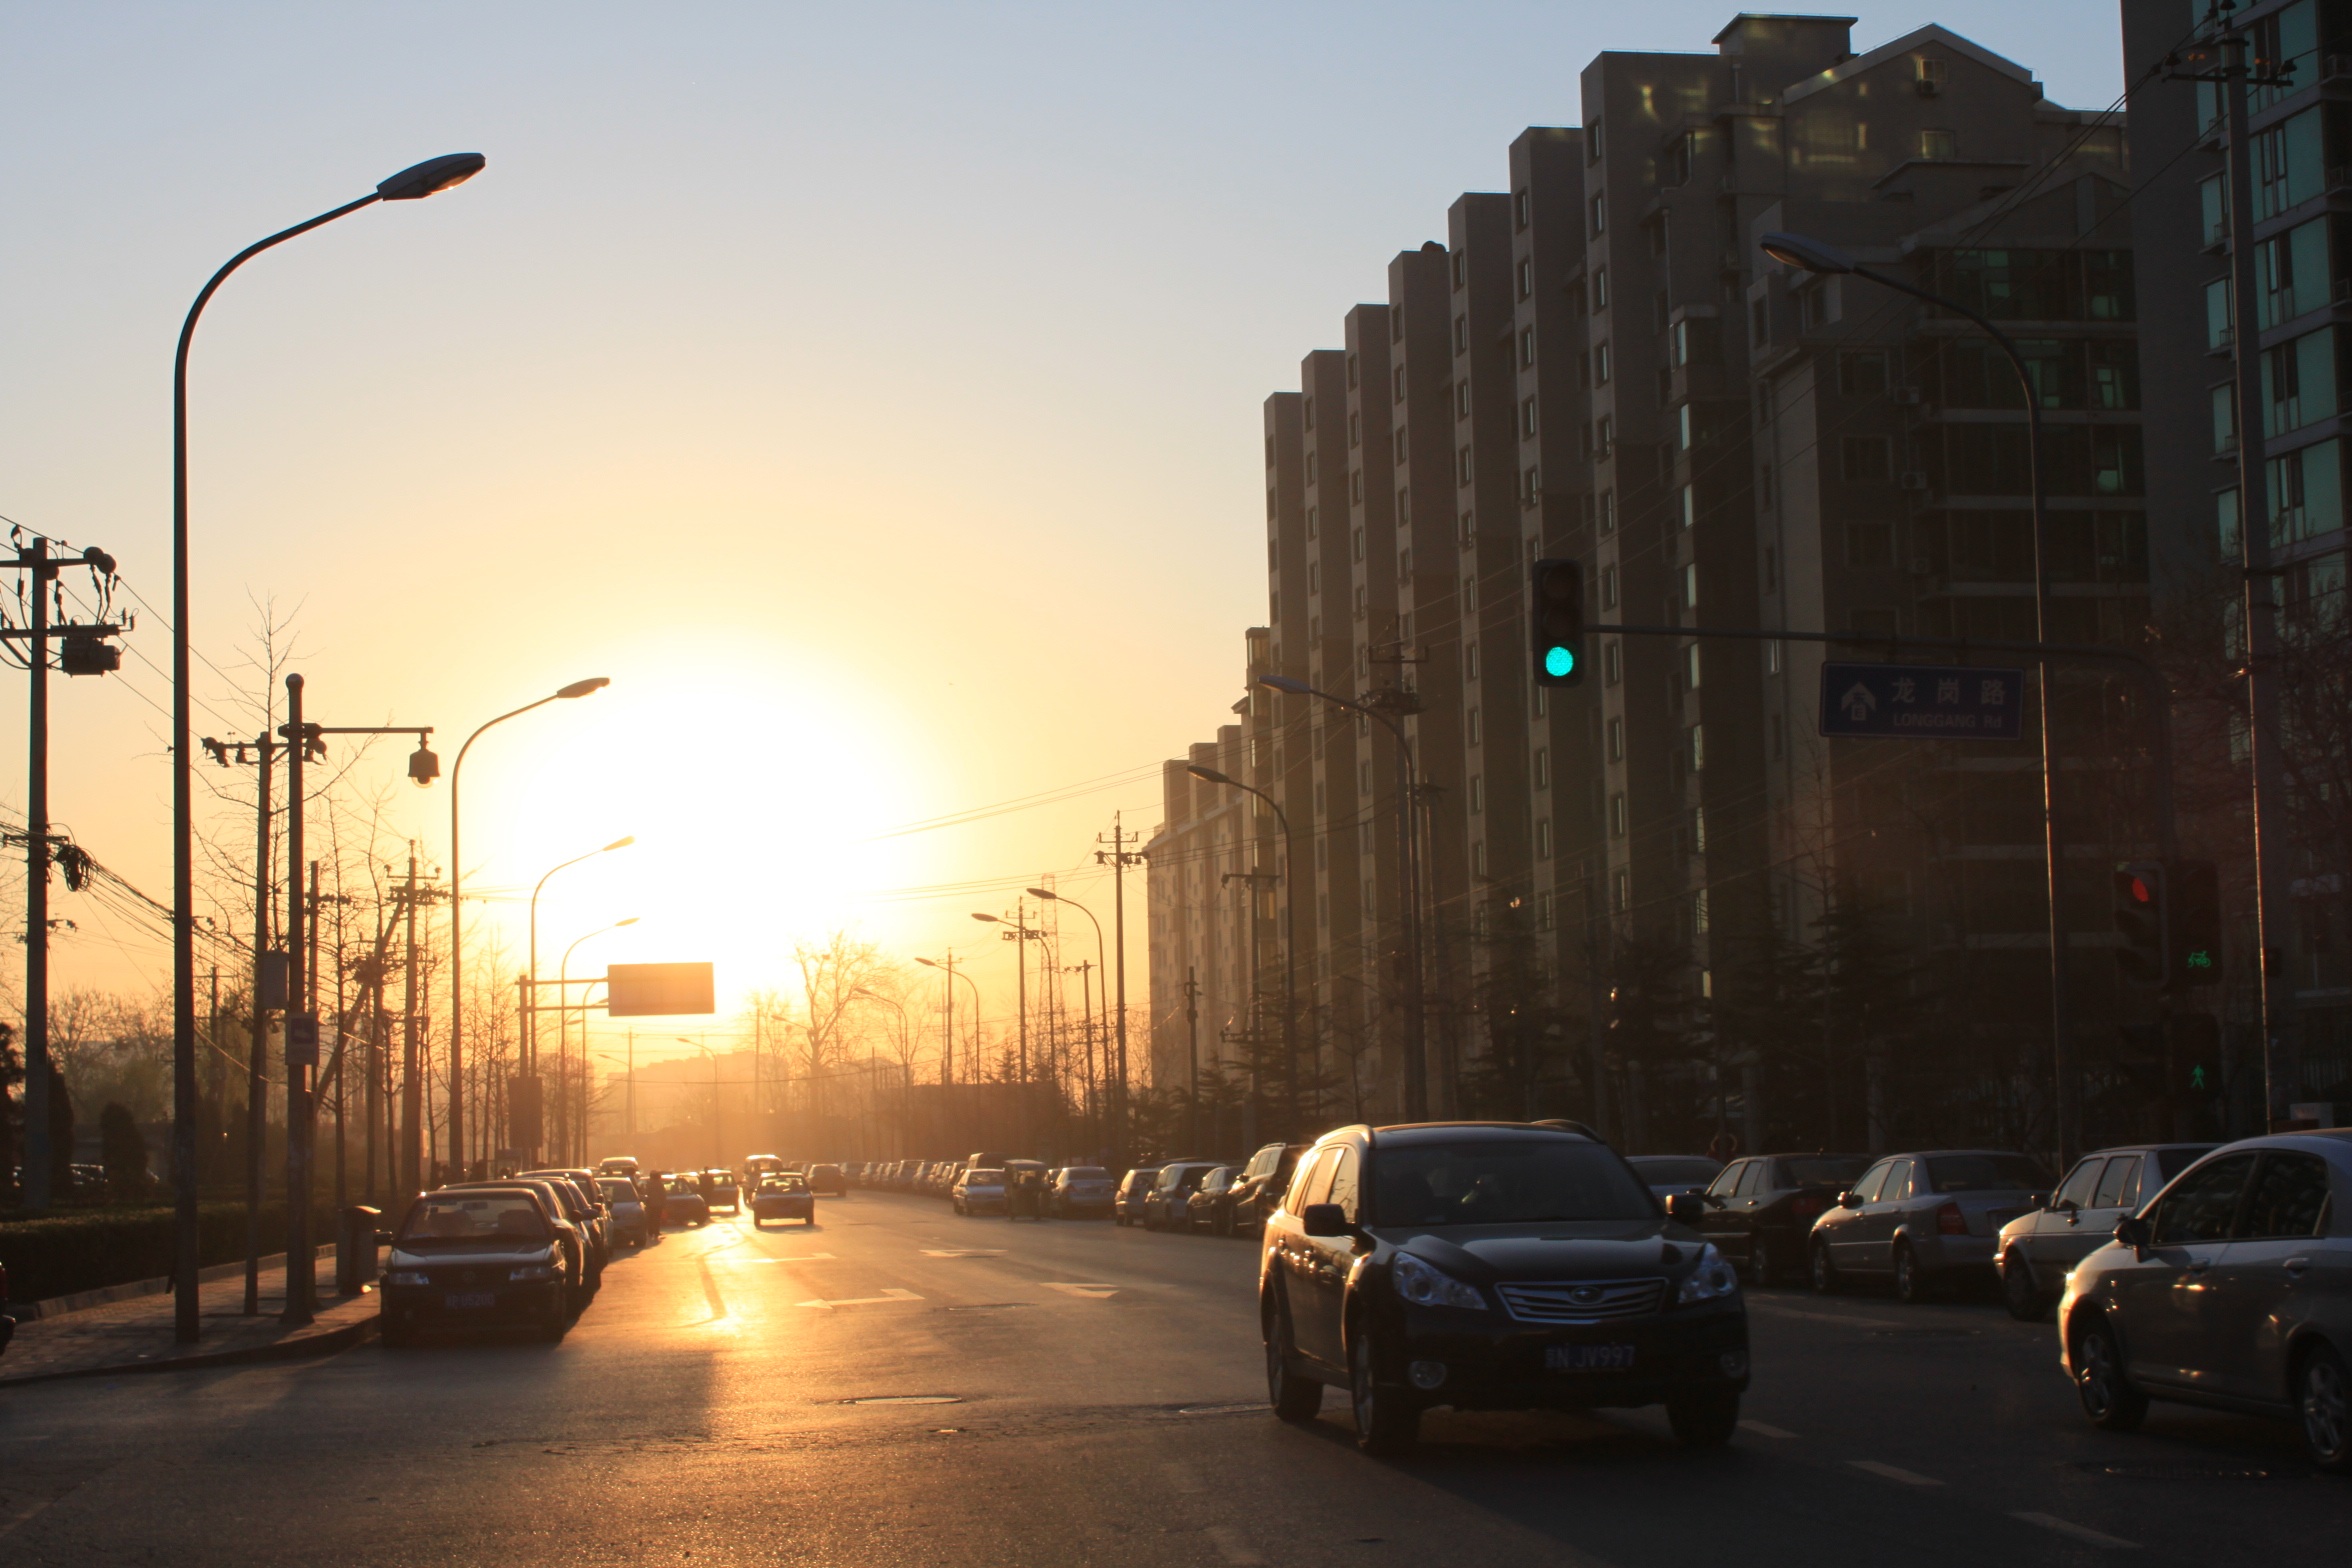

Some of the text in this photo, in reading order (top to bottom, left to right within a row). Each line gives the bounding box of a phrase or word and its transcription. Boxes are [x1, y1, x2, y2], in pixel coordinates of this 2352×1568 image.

[1891, 676, 2006, 705] 龙岗路
[1893, 713, 2002, 728] LONGGANG Rd
